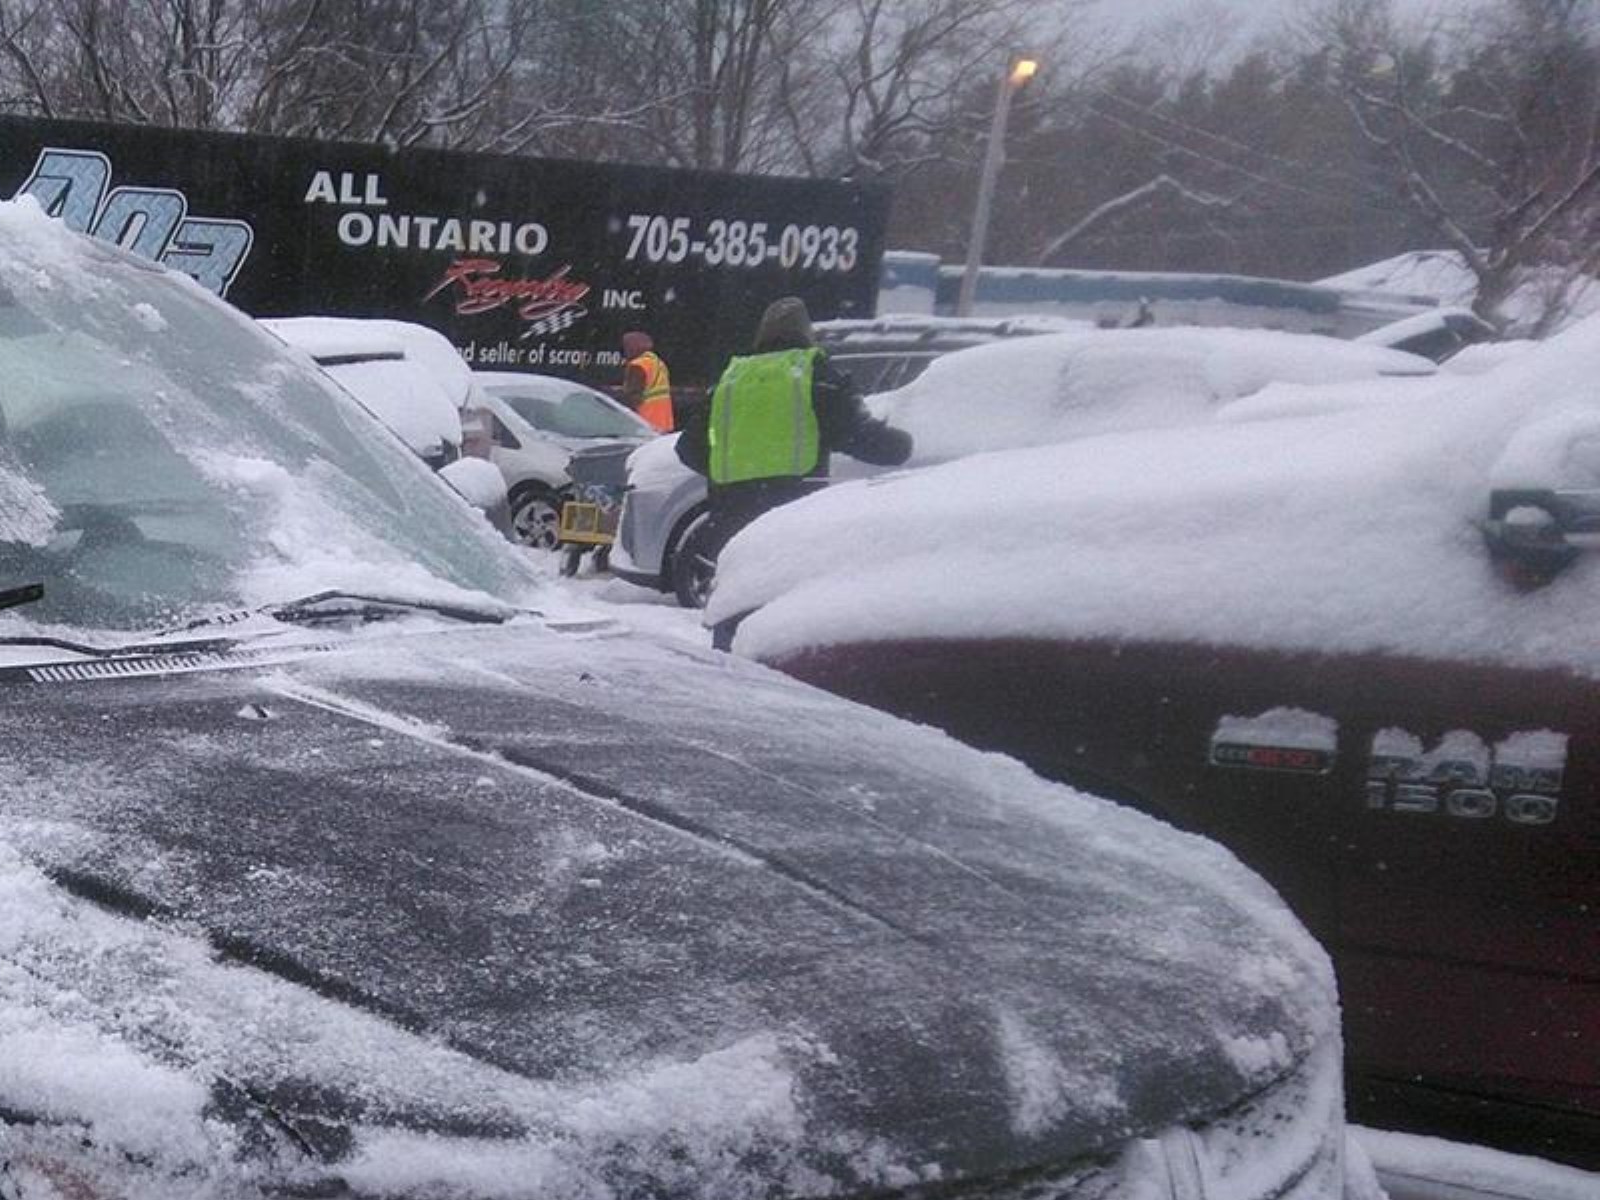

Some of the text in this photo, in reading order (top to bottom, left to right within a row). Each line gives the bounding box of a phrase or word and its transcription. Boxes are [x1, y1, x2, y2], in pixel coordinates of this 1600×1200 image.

[305, 171, 388, 206] ALL
[337, 211, 549, 255] ONTARIO
[623, 214, 859, 271] 705-385-0933
[602, 289, 647, 310] INC.
[479, 341, 525, 365] seller
[529, 343, 546, 366] of
